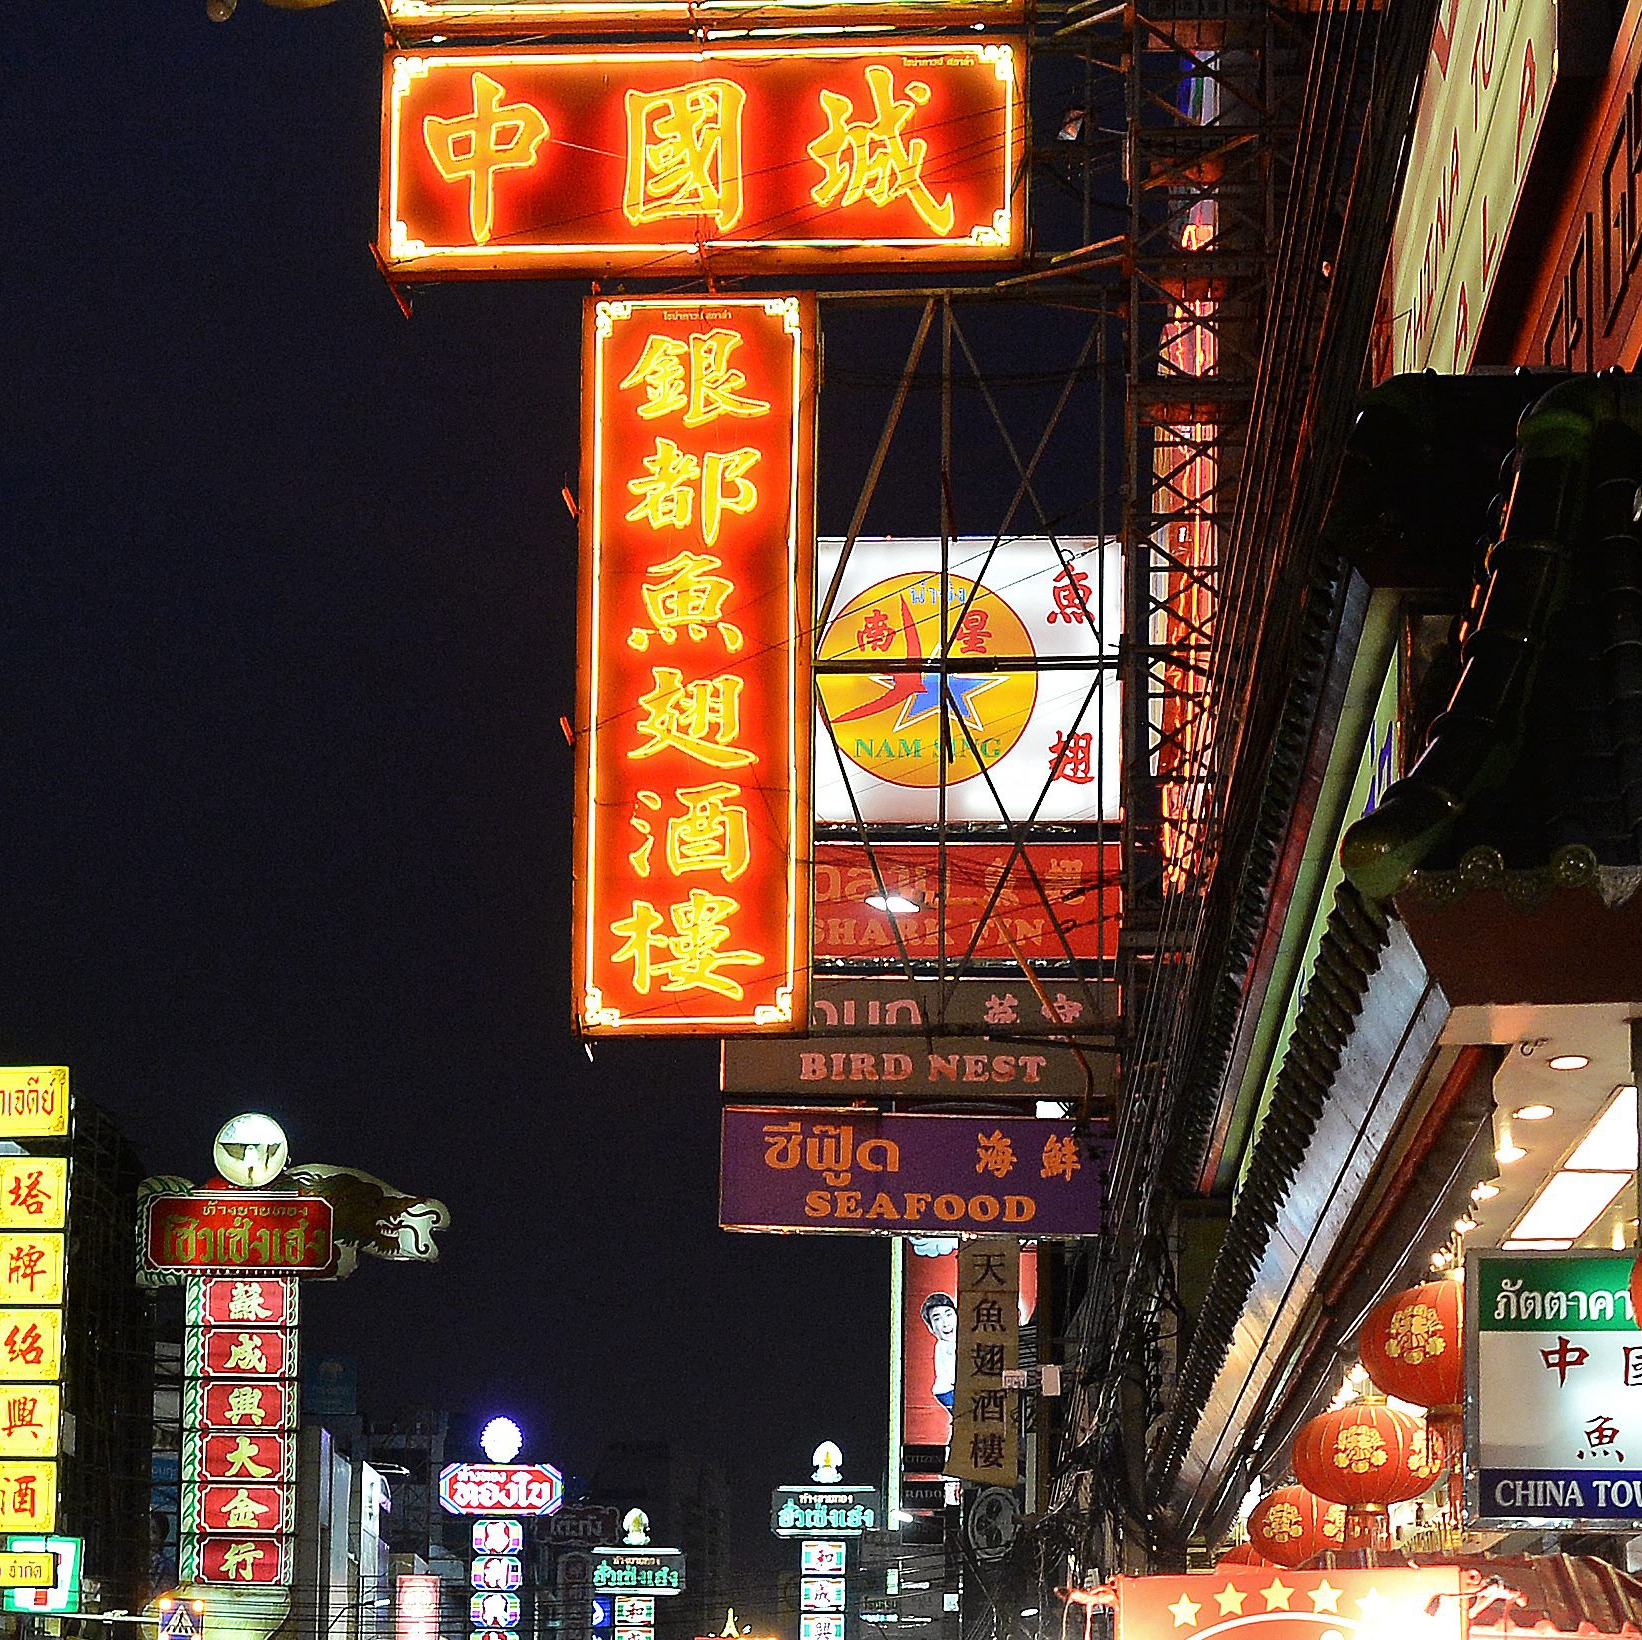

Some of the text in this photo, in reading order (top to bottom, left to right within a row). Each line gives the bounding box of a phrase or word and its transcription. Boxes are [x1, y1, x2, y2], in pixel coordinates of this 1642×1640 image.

[423, 67, 954, 244] 中國城
[611, 330, 771, 1000] 銀都魚翅酒樓
[854, 739, 921, 757] NAM
[799, 1053, 1046, 1083] BIRD NEST
[976, 1130, 1081, 1181] 海鮮
[805, 1190, 1036, 1222] SEAFOOD
[905, 1489, 942, 1499] RADO
[1495, 1480, 1585, 1510] CHINA
